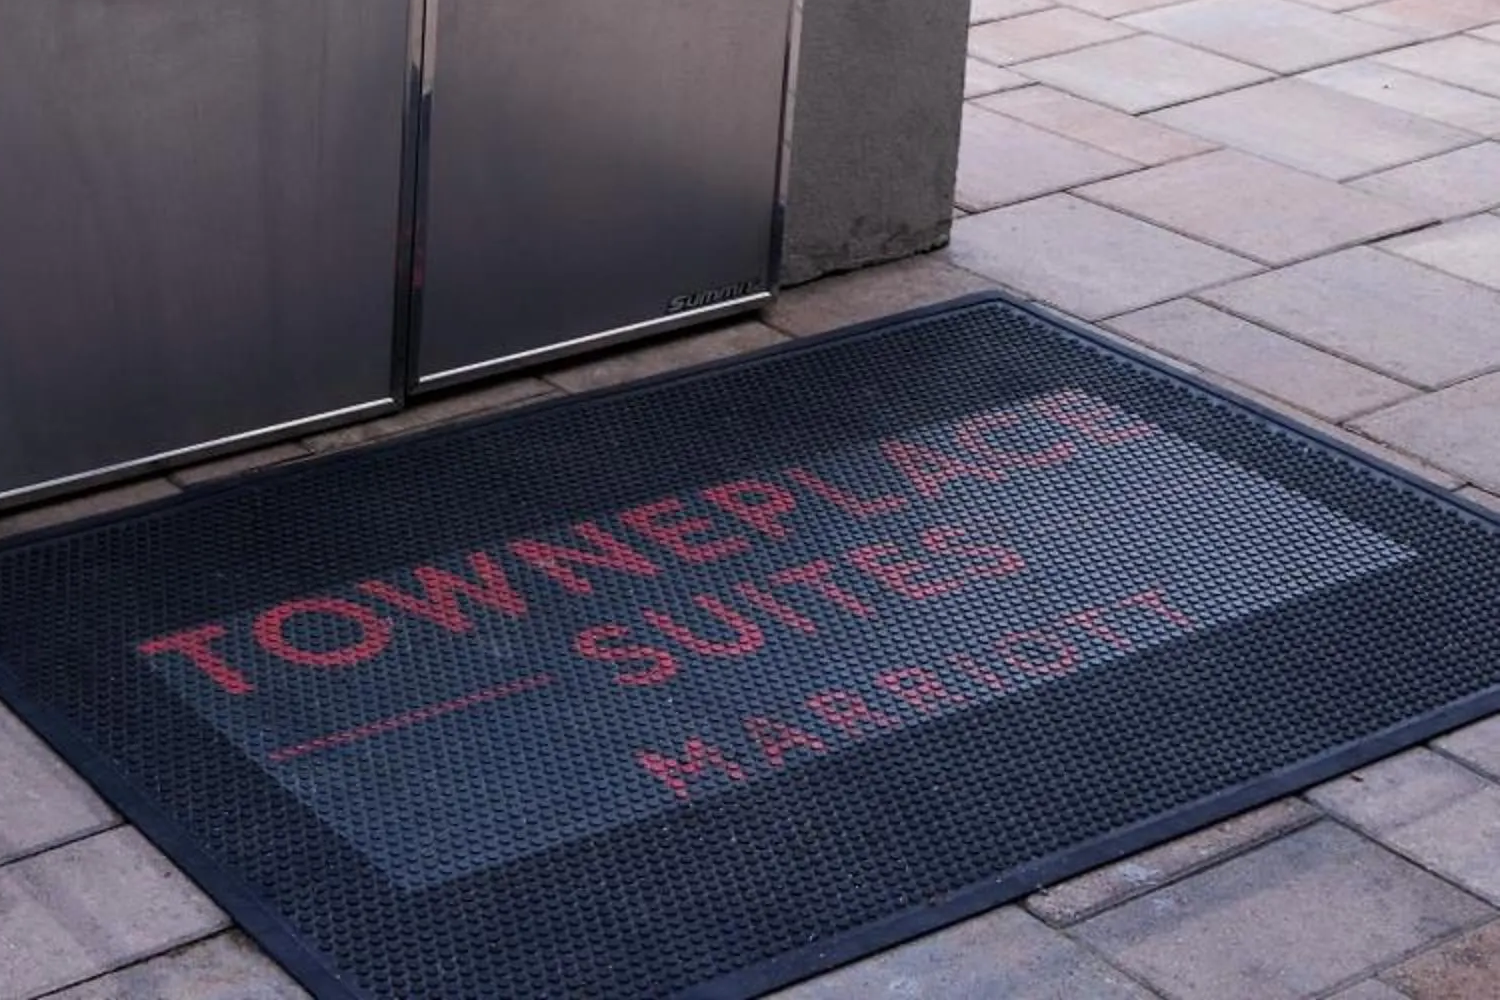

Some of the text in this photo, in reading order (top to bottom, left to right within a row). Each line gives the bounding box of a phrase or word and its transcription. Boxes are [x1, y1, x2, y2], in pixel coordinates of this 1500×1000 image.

[138, 388, 1158, 694] TOWNEPLACE
[572, 525, 1026, 686] SUITES
[635, 587, 1196, 800] MARRIOTT
